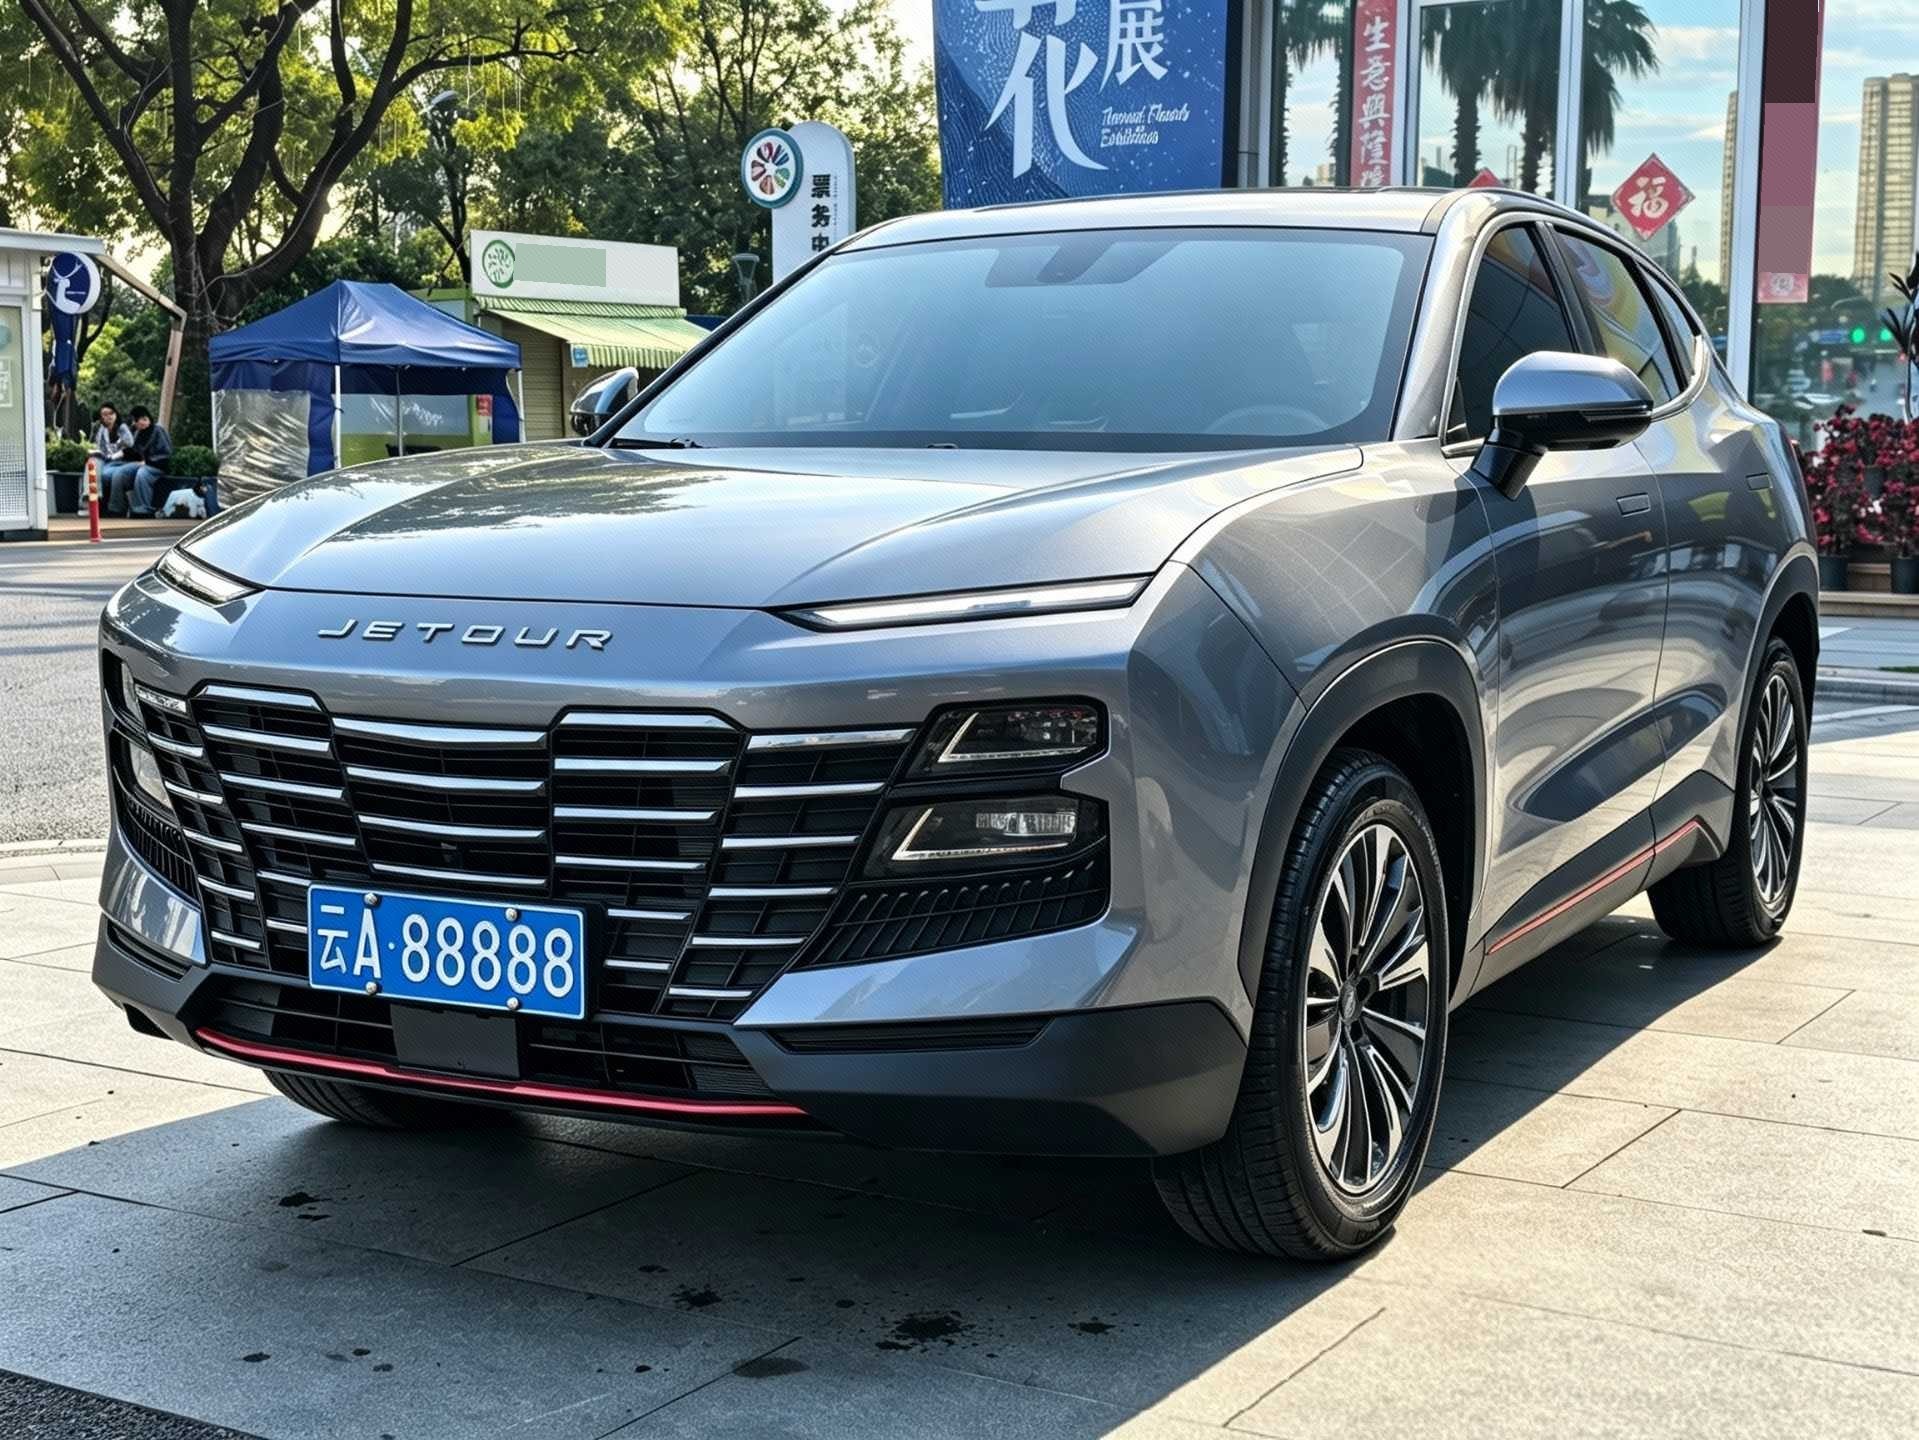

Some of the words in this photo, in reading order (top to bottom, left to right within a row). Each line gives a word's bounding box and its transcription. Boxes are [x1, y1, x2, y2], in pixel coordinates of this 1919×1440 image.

[1628, 176, 1669, 218] 福
[318, 618, 612, 650] JETOUR
[317, 905, 575, 999] 云A·88888
